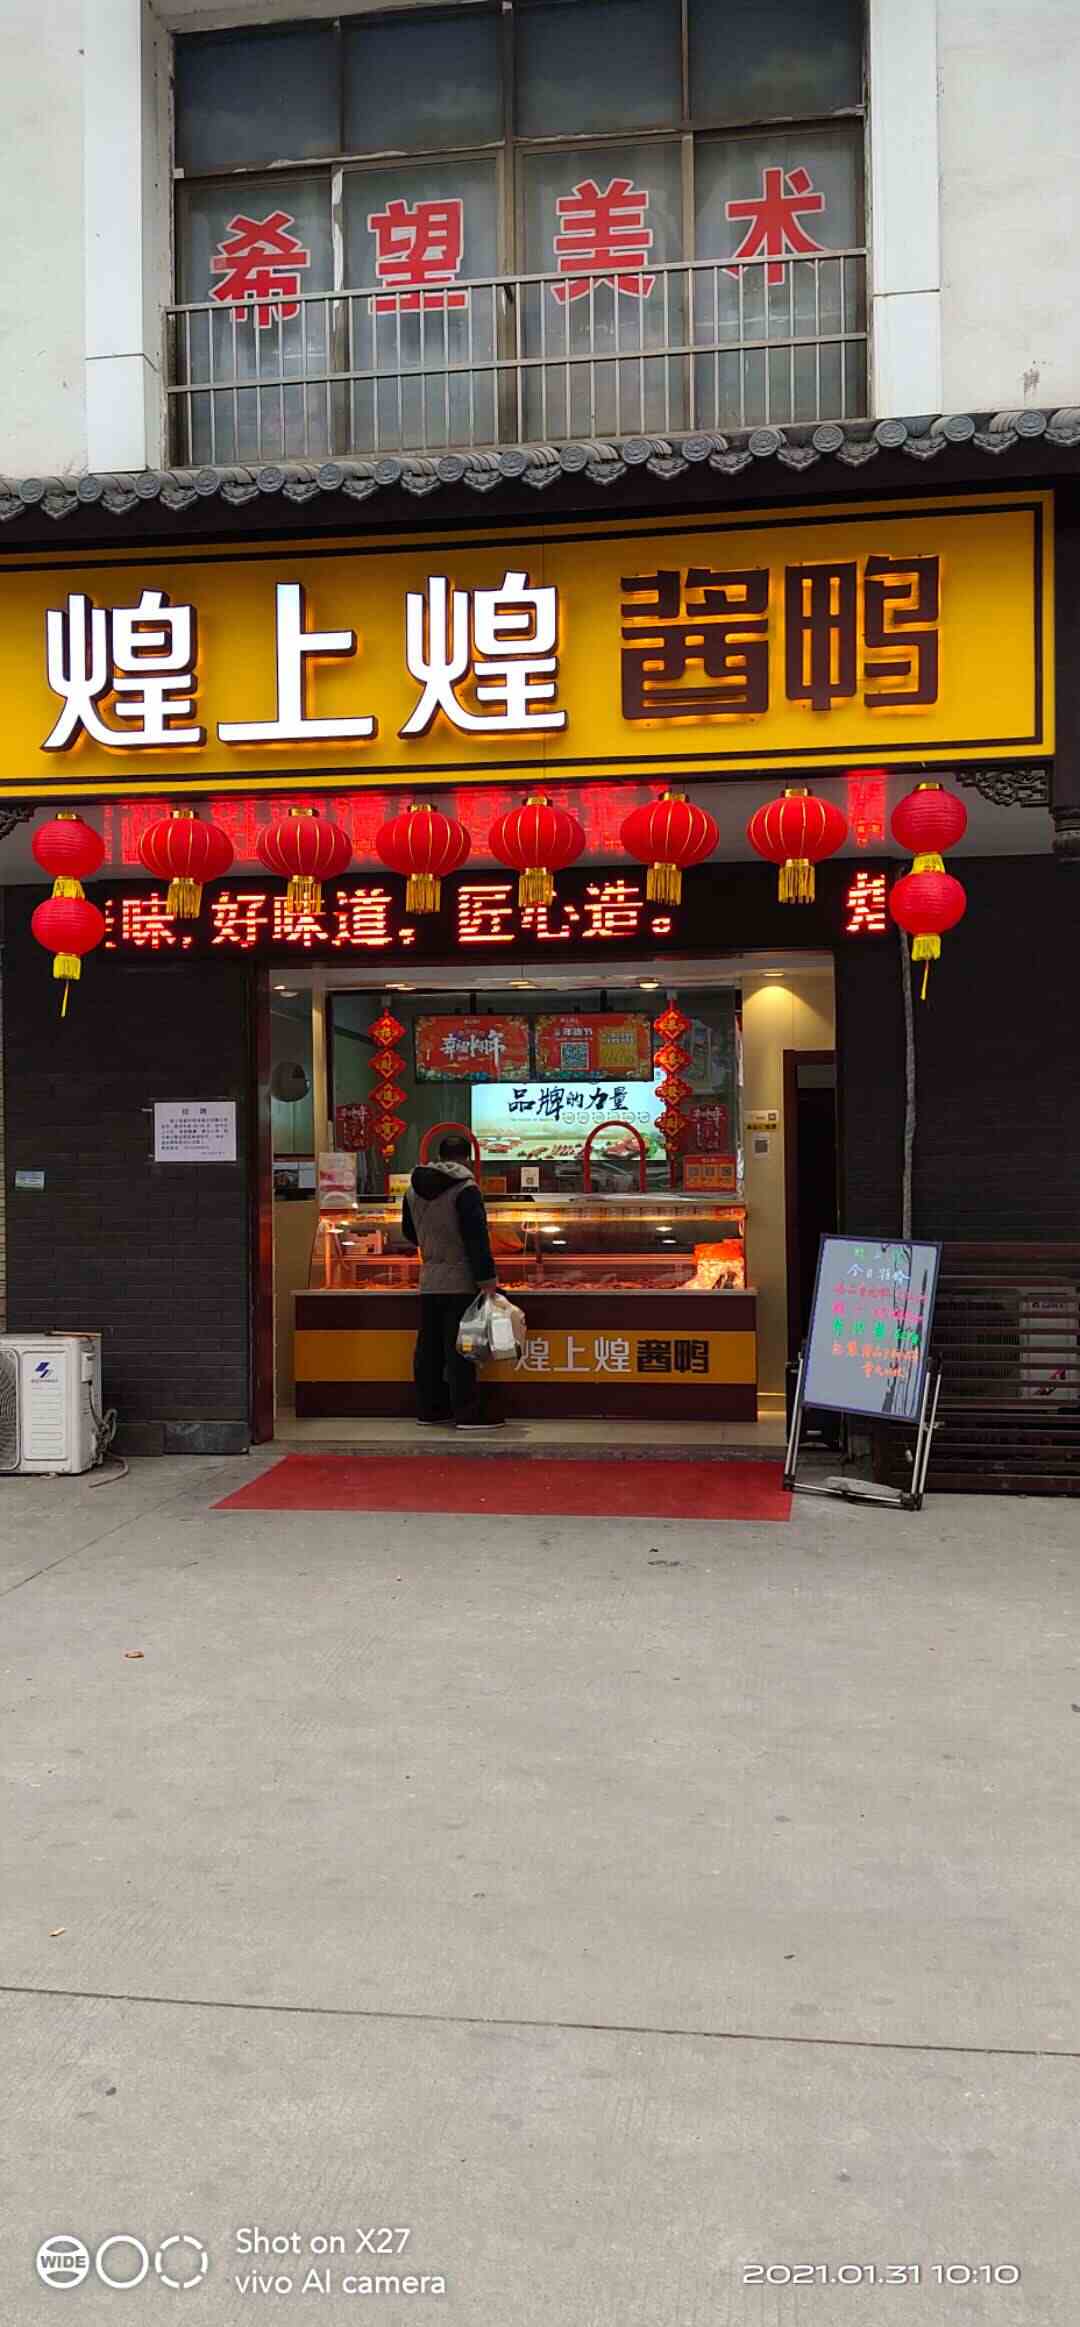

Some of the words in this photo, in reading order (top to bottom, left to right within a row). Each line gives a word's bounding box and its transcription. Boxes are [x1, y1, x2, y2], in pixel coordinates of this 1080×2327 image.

[210, 167, 825, 329] 希望美术
[40, 553, 940, 754] 煌上煌酱鸭
[508, 1086, 629, 1121] 品牌的力量
